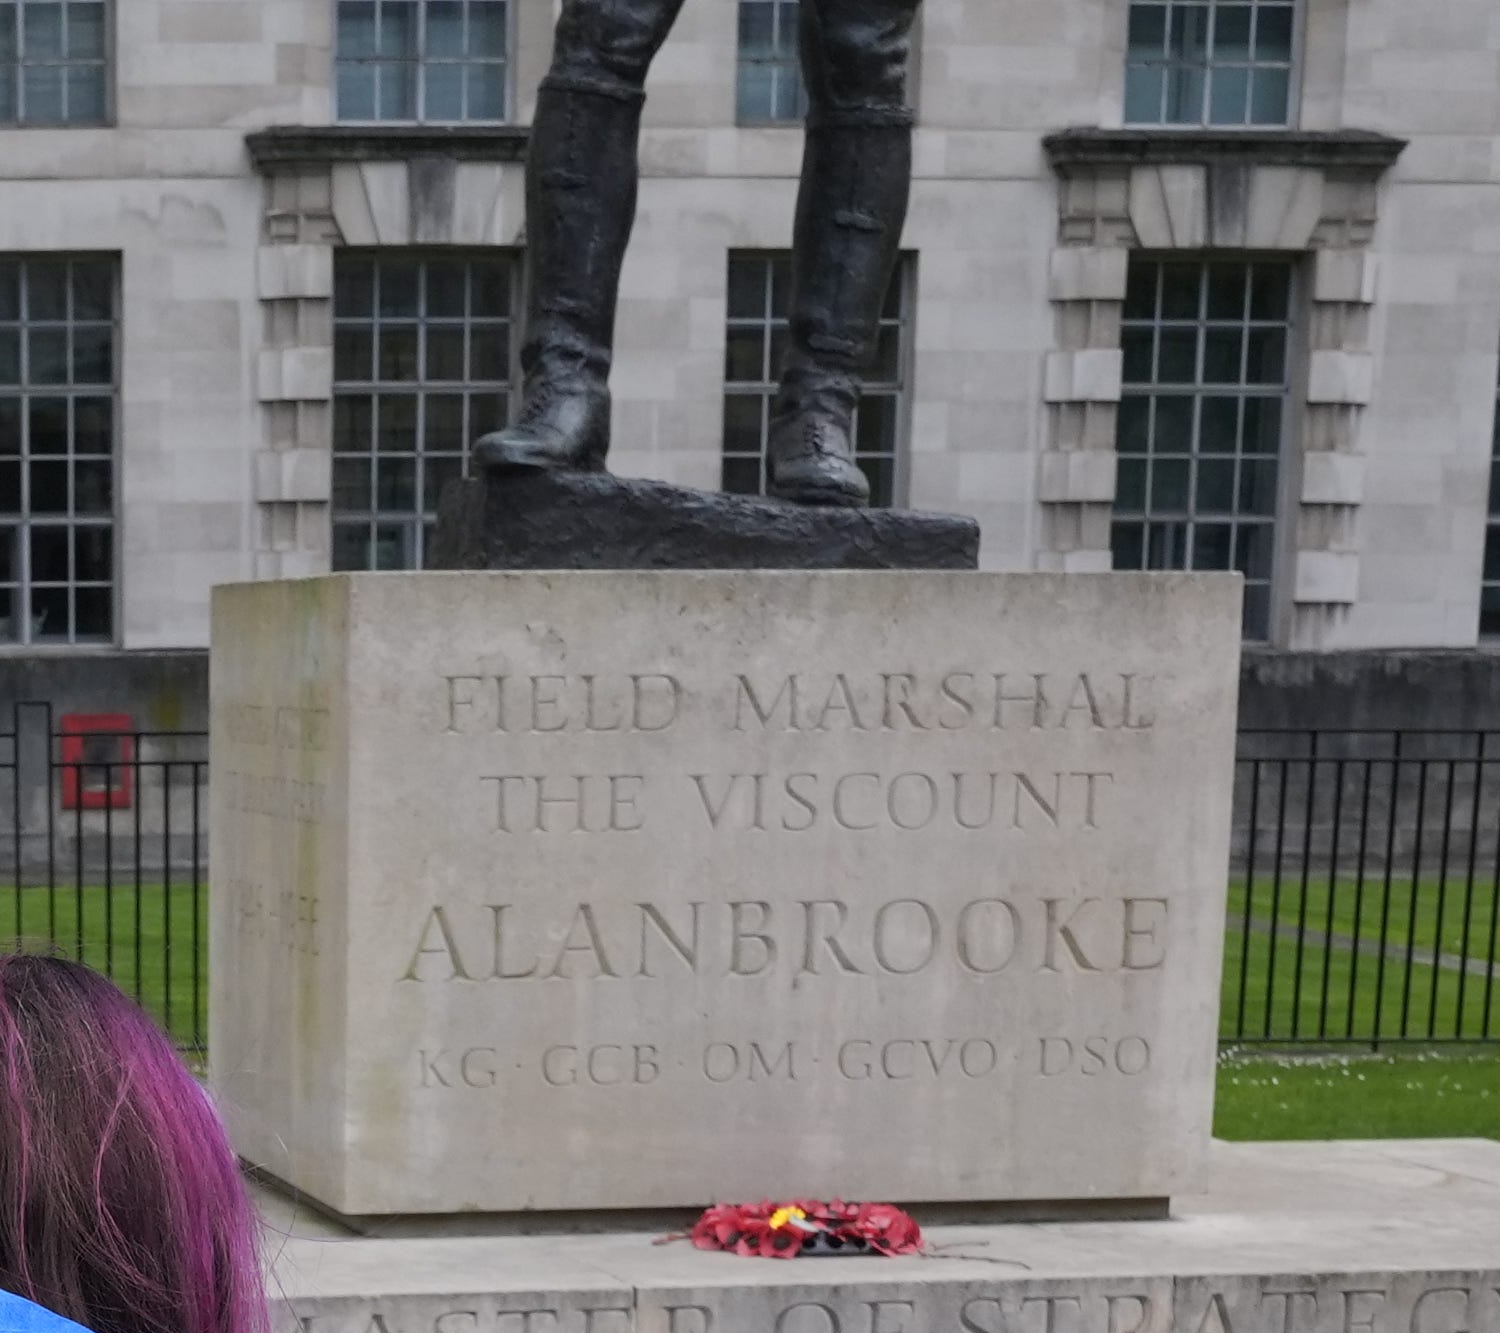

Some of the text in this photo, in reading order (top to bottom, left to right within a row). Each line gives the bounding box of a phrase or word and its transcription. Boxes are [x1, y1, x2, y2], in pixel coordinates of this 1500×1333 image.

[441, 671, 1157, 733] FIELD MARSHAL
[480, 770, 1114, 834] THE VISCOUNT
[402, 895, 1170, 983] ALANBROOKE
[419, 1033, 1152, 1090] KG GCB OM GCVO DSO
